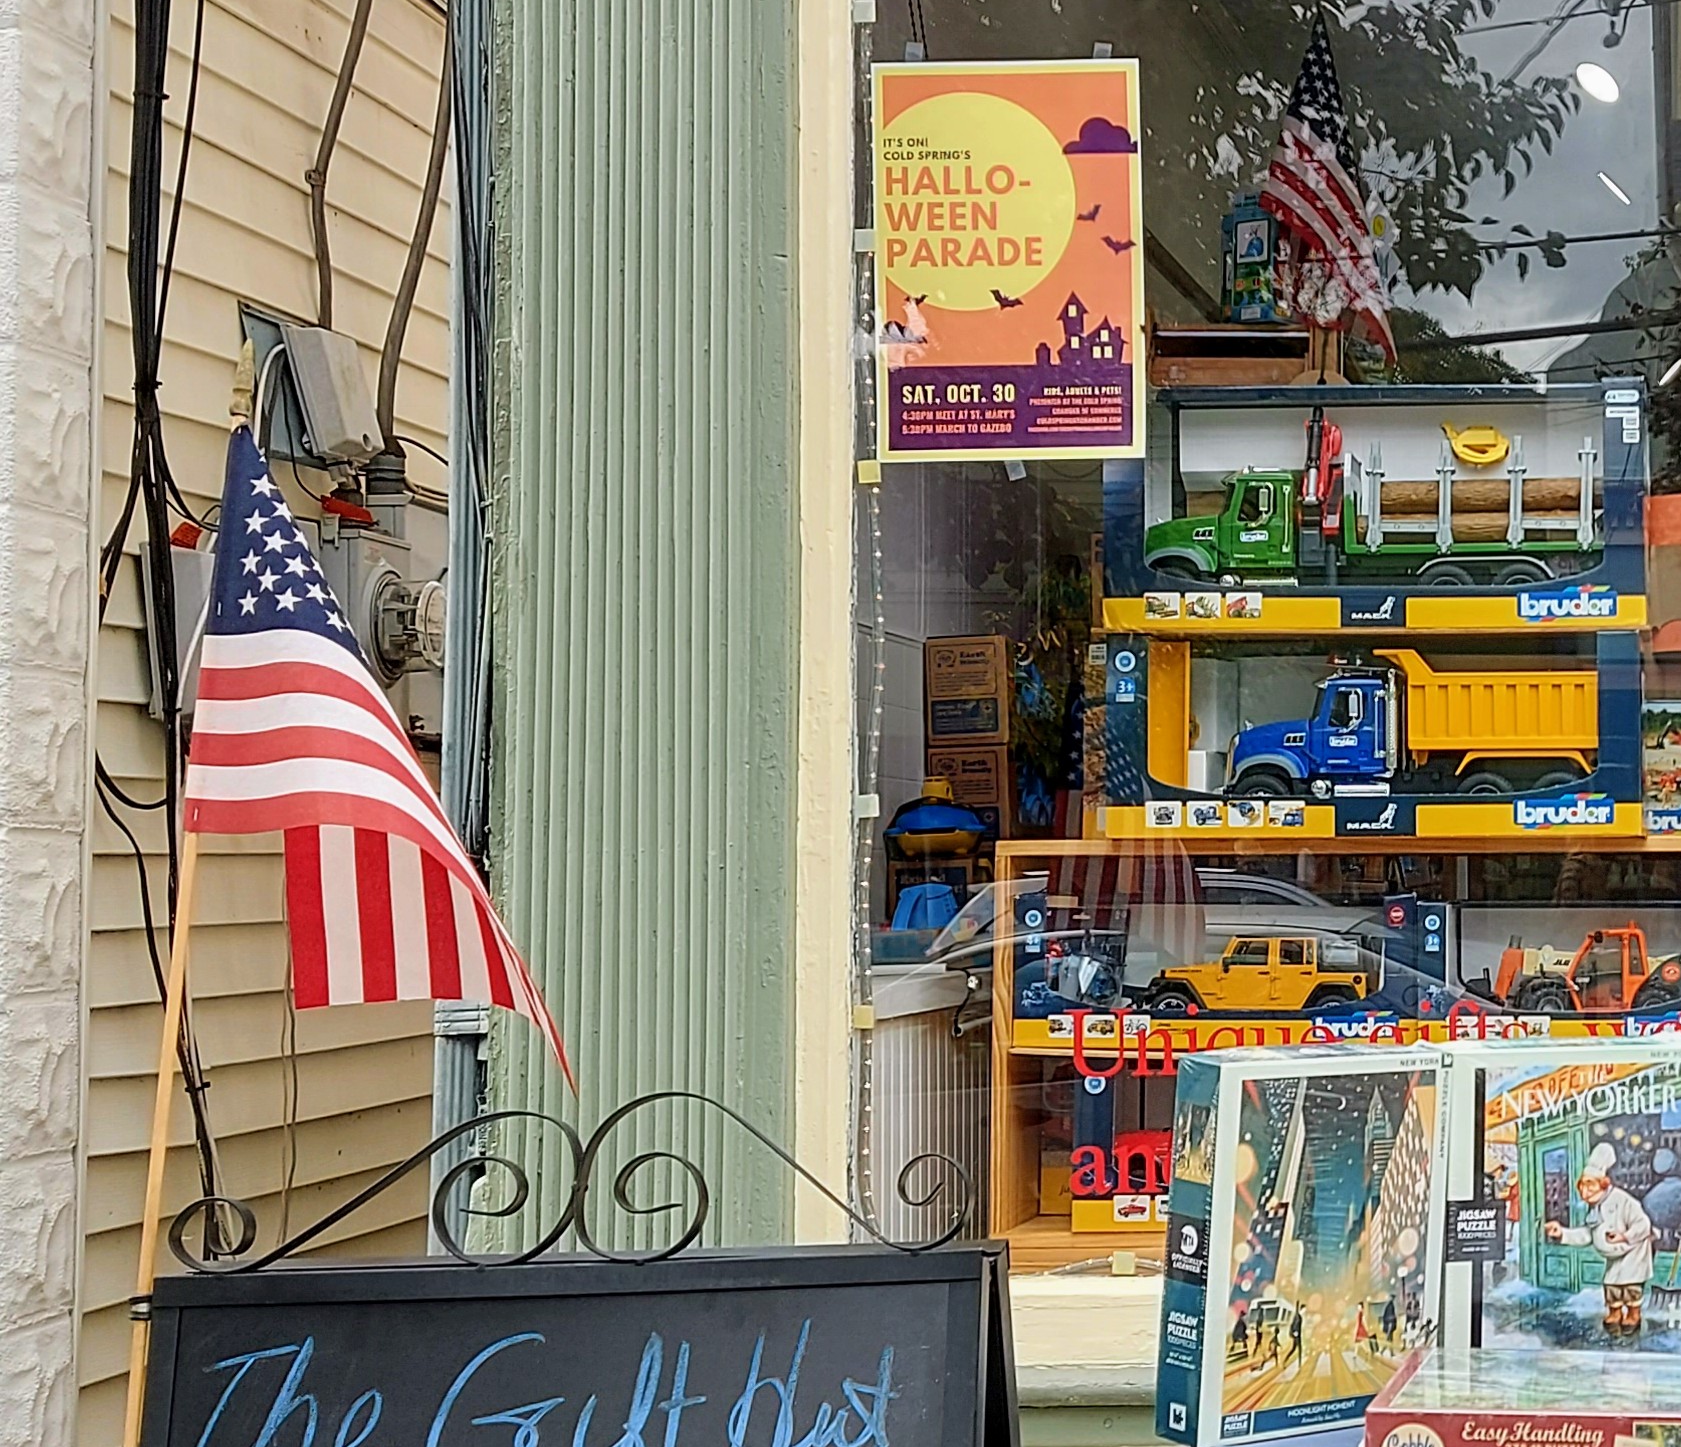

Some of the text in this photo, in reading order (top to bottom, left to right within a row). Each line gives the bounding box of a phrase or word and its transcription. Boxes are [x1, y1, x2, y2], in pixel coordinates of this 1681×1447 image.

[882, 137, 929, 149] IT'S ON!
[883, 149, 972, 162] COLD SPRING'S
[885, 164, 1032, 197] HALLO-
[884, 201, 998, 233] WEEN
[886, 236, 1044, 269] PARADE
[901, 383, 1016, 406] SAT, OCT. 30
[1519, 592, 1615, 617] bruder
[1350, 611, 1391, 620] MACK
[1515, 799, 1612, 824] bruder
[1346, 821, 1394, 830] MACK
[1500, 1084, 1680, 1122] NEW YORKER
[1069, 1145, 1174, 1197] an
[1456, 1208, 1497, 1221] JIGSAW
[1456, 1219, 1497, 1232] PUZZLE
[1168, 1311, 1199, 1327] JIGSAW
[1166, 1322, 1198, 1342] PUZZLE
[1223, 1421, 1249, 1431] PUZZLE
[1461, 1421, 1512, 1447] Easy
